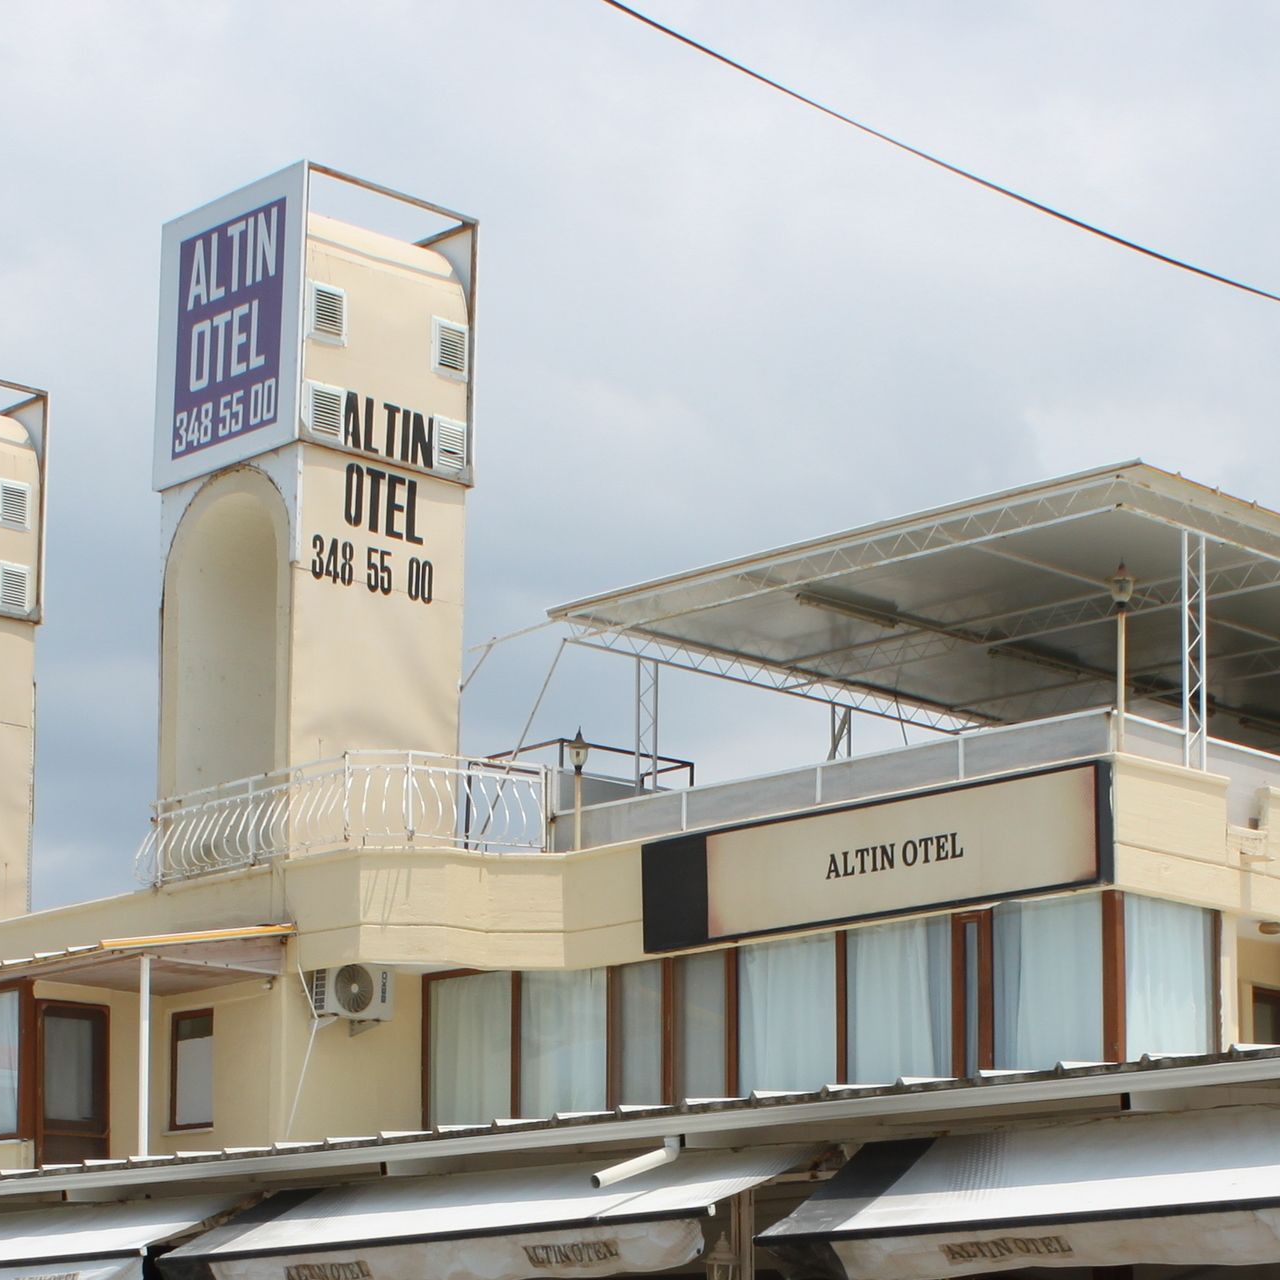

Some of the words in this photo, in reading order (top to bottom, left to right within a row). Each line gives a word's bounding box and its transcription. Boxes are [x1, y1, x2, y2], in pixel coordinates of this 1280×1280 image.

[187, 206, 278, 312] ALTIN
[189, 299, 266, 392] OTEL
[175, 401, 213, 453] 348
[219, 390, 244, 437] 55
[249, 378, 276, 425] 00
[344, 390, 434, 469] ALTIN
[344, 462, 424, 545] OTEL
[311, 534, 354, 587] 348
[366, 546, 392, 596] 55
[407, 556, 433, 604] 00
[825, 843, 895, 880] ALTIN
[901, 832, 964, 867] OTEL
[330, 1261, 370, 1280] OTEL
[570, 1240, 618, 1263] OTEL
[944, 1241, 1013, 1260] ALTIN
[1014, 1236, 1073, 1254] OTEL
